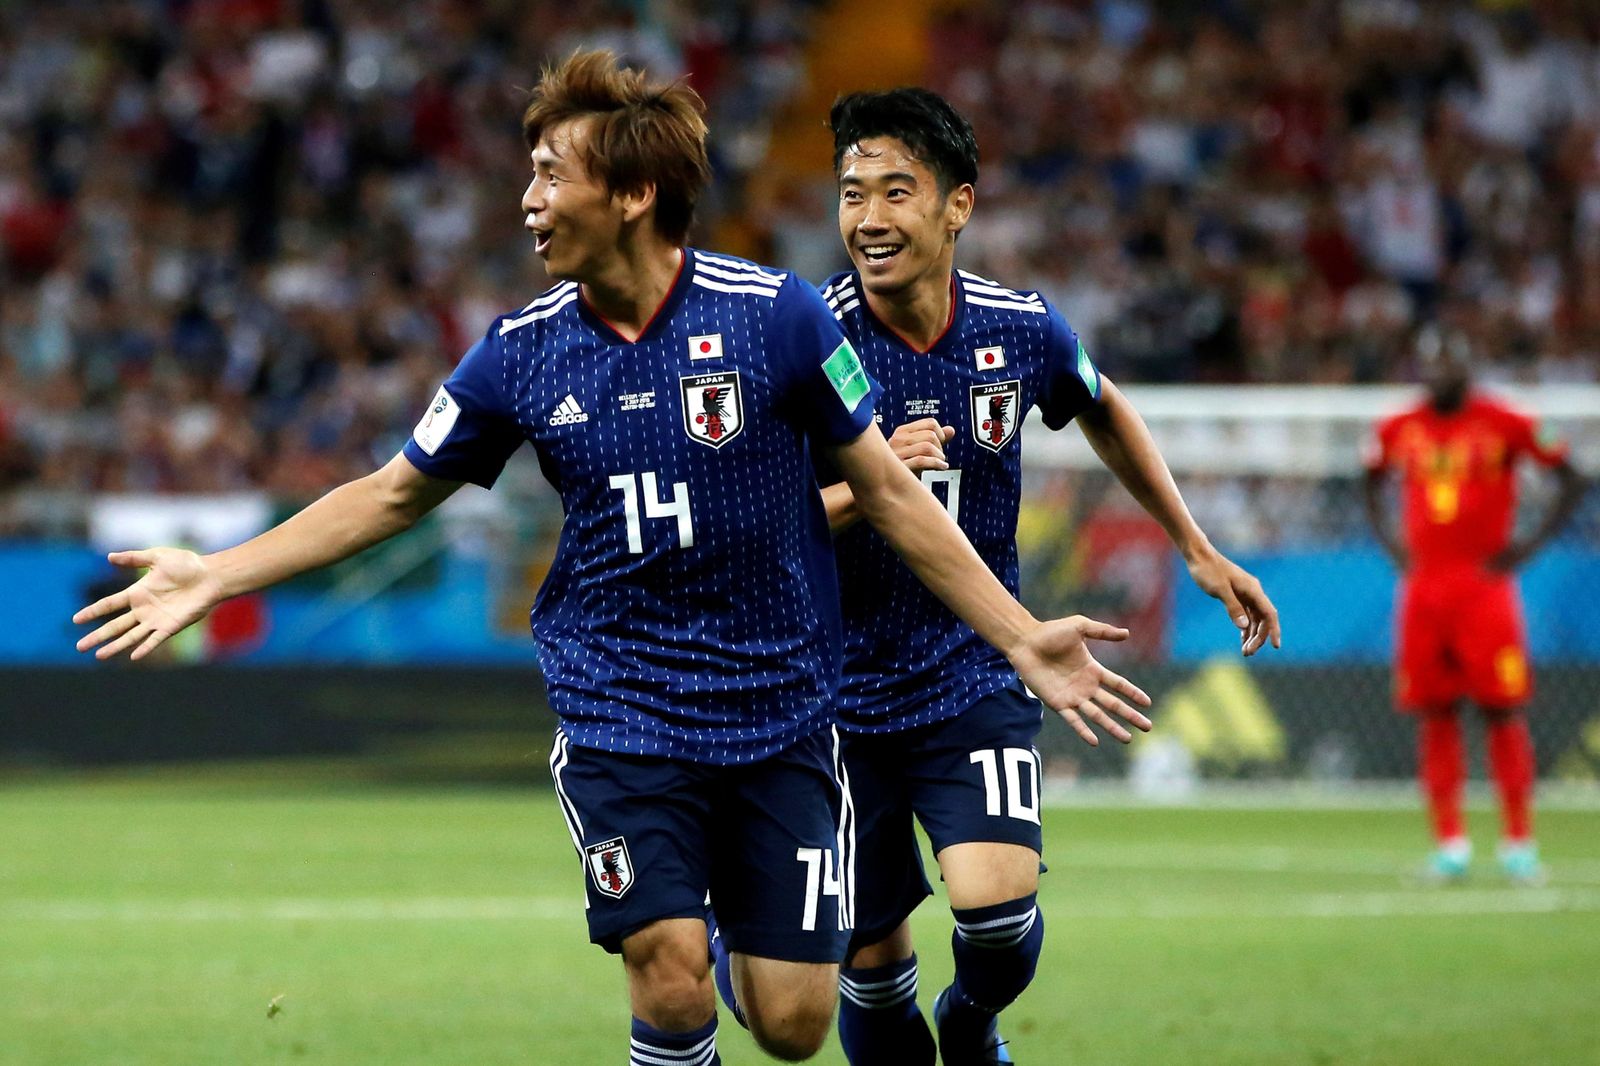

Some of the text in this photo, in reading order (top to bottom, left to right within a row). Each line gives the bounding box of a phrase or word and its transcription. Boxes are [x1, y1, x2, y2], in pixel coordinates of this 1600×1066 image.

[695, 376, 725, 385] JAPAN
[984, 385, 1009, 394] JAPAN
[549, 412, 589, 427] adidas
[608, 471, 694, 554] 14
[969, 747, 1042, 826] 10
[595, 841, 615, 852] JAPAN
[796, 847, 844, 931] 14
